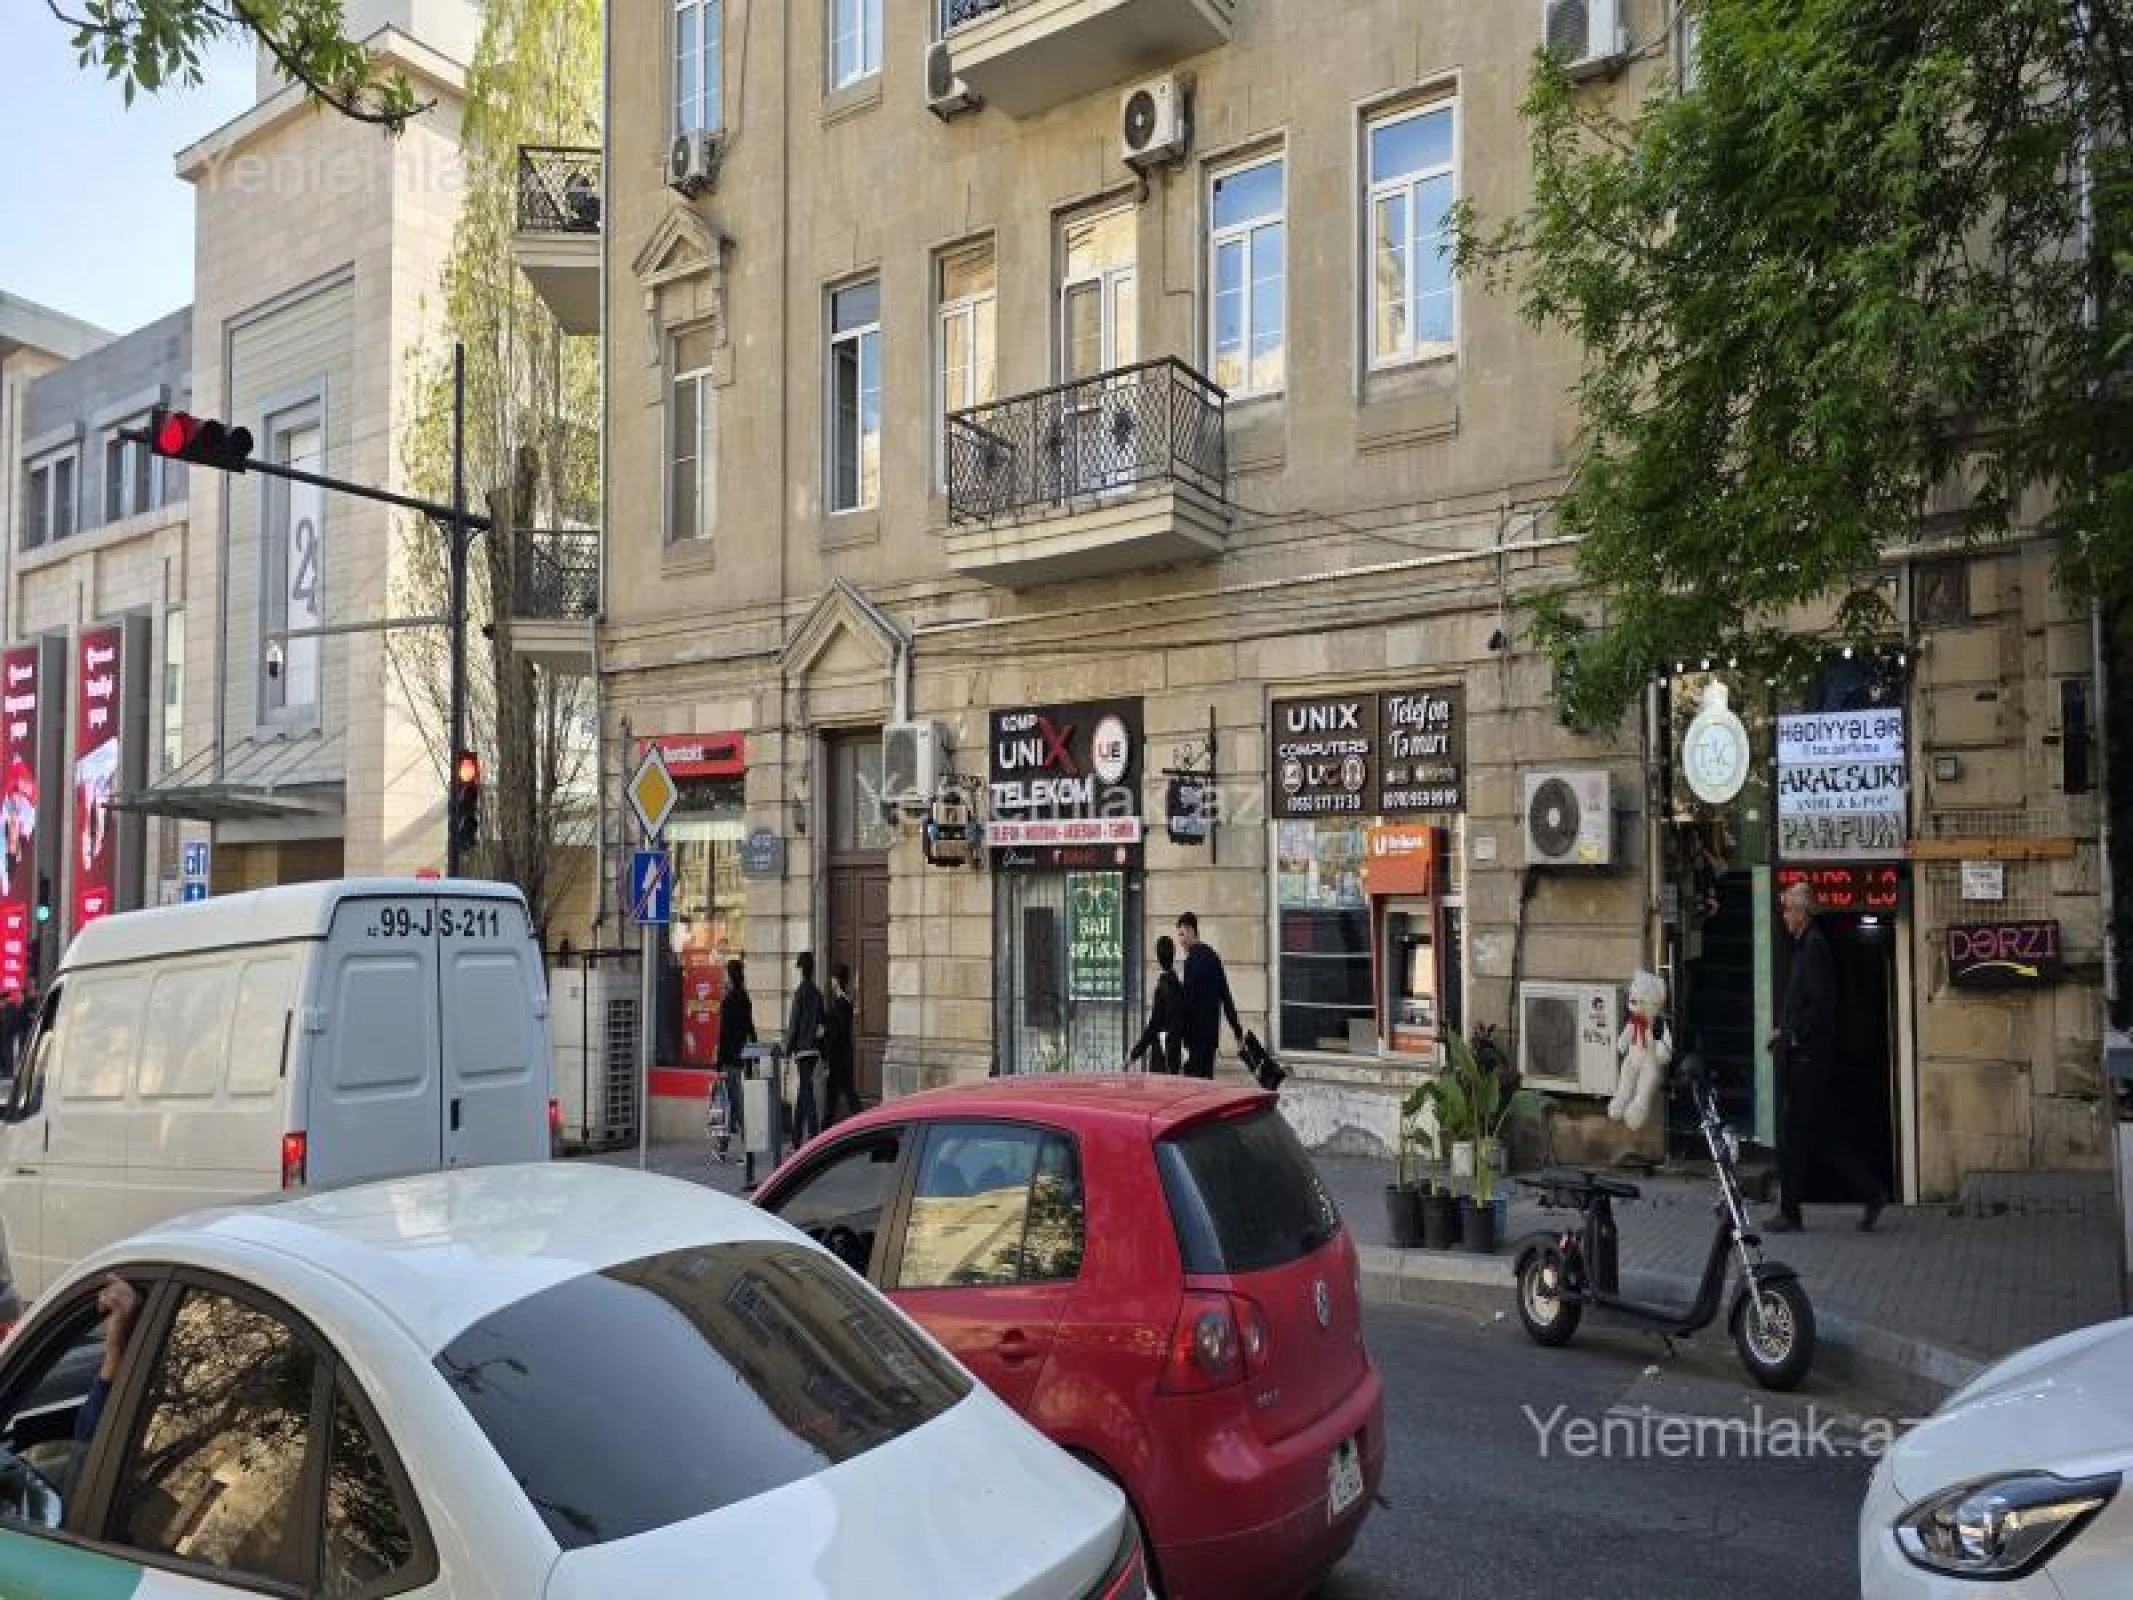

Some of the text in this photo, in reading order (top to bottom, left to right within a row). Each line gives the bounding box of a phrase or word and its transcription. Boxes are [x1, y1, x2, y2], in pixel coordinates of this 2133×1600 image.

[1287, 704, 1358, 731] UNIX
[999, 716, 1078, 774] UNIX
[1279, 738, 1368, 758] COMPUTERS
[991, 775, 1094, 809] TELEKOM
[381, 906, 499, 937] 99-JS-211
